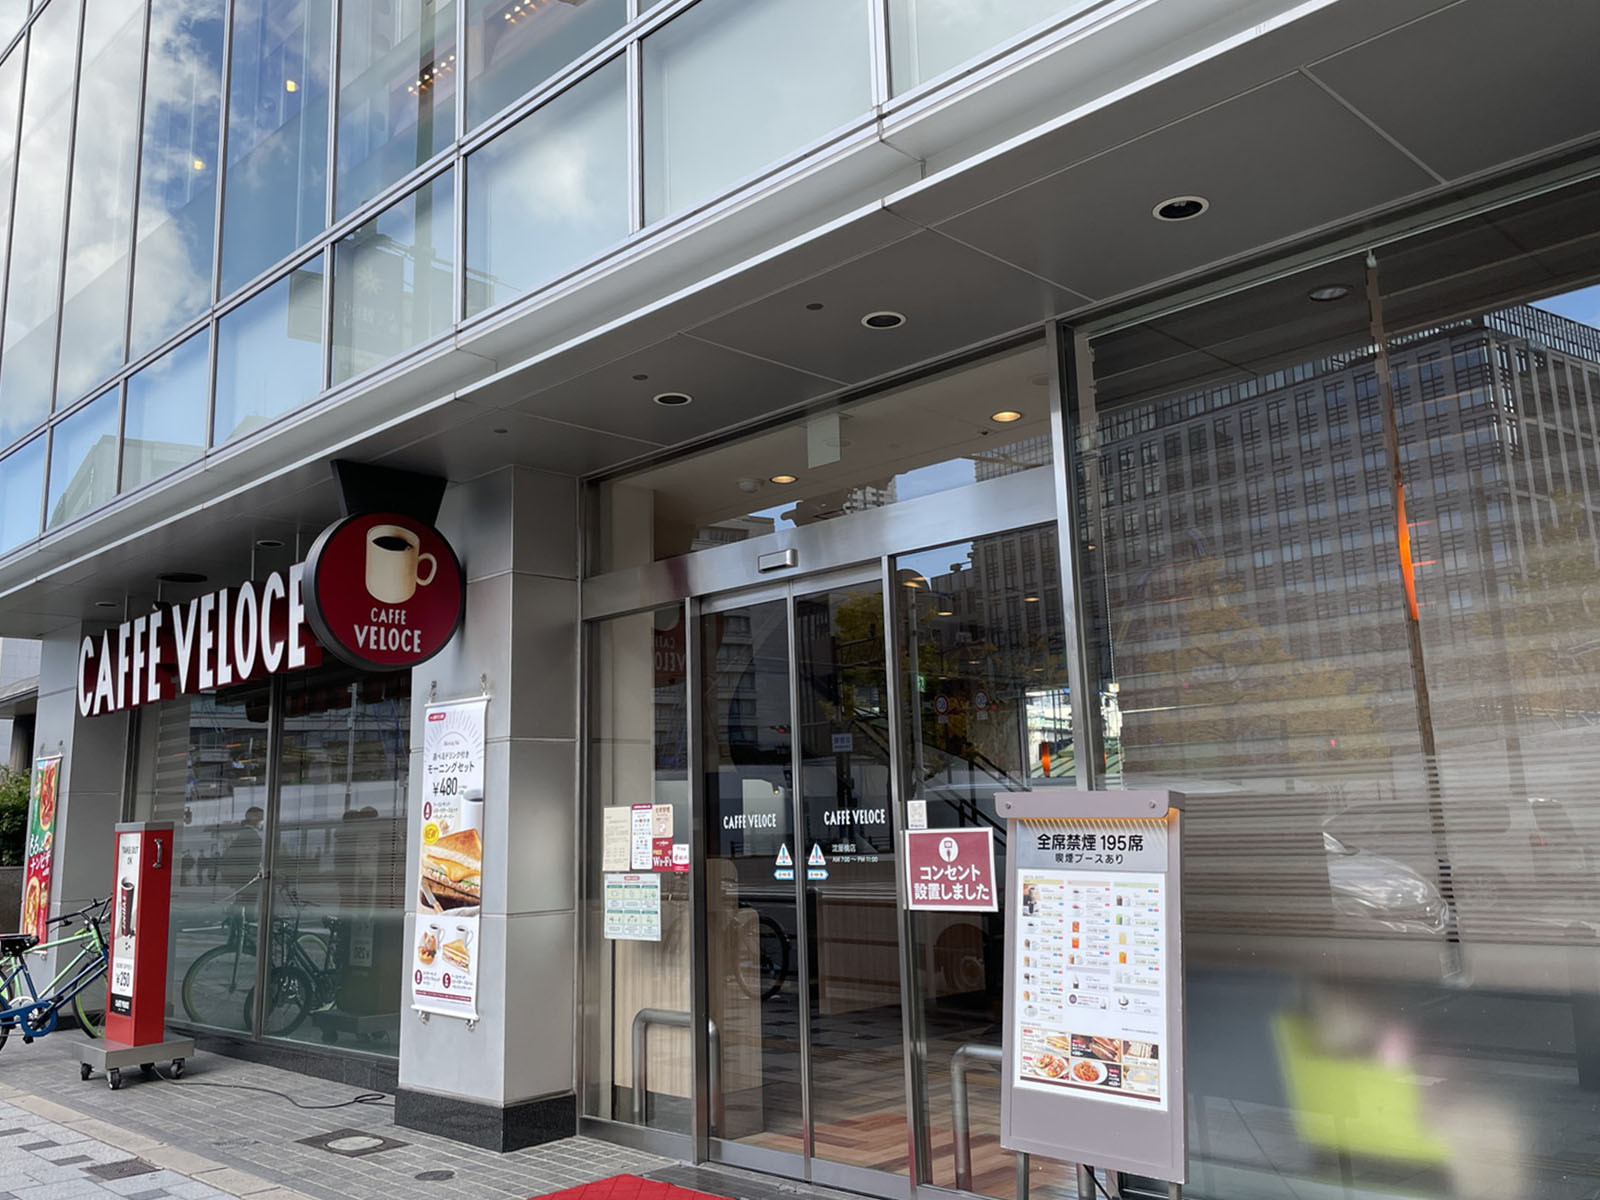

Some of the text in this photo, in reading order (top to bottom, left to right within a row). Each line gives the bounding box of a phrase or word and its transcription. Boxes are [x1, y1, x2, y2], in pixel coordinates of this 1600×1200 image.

[172, 562, 305, 694] VELOCE
[353, 624, 422, 653] VELOCE
[428, 762, 475, 774] モーニングセット
[433, 777, 458, 796] ¥480
[748, 813, 776, 828] VELOCE
[852, 809, 886, 824] VELOCE
[1037, 833, 1144, 851] 全席禁煙 195席
[653, 856, 673, 867] Wi-Fi
[1055, 853, 1124, 865] 喫煙ブースあり
[920, 864, 981, 881] コンセント
[914, 883, 990, 900] 設置しました
